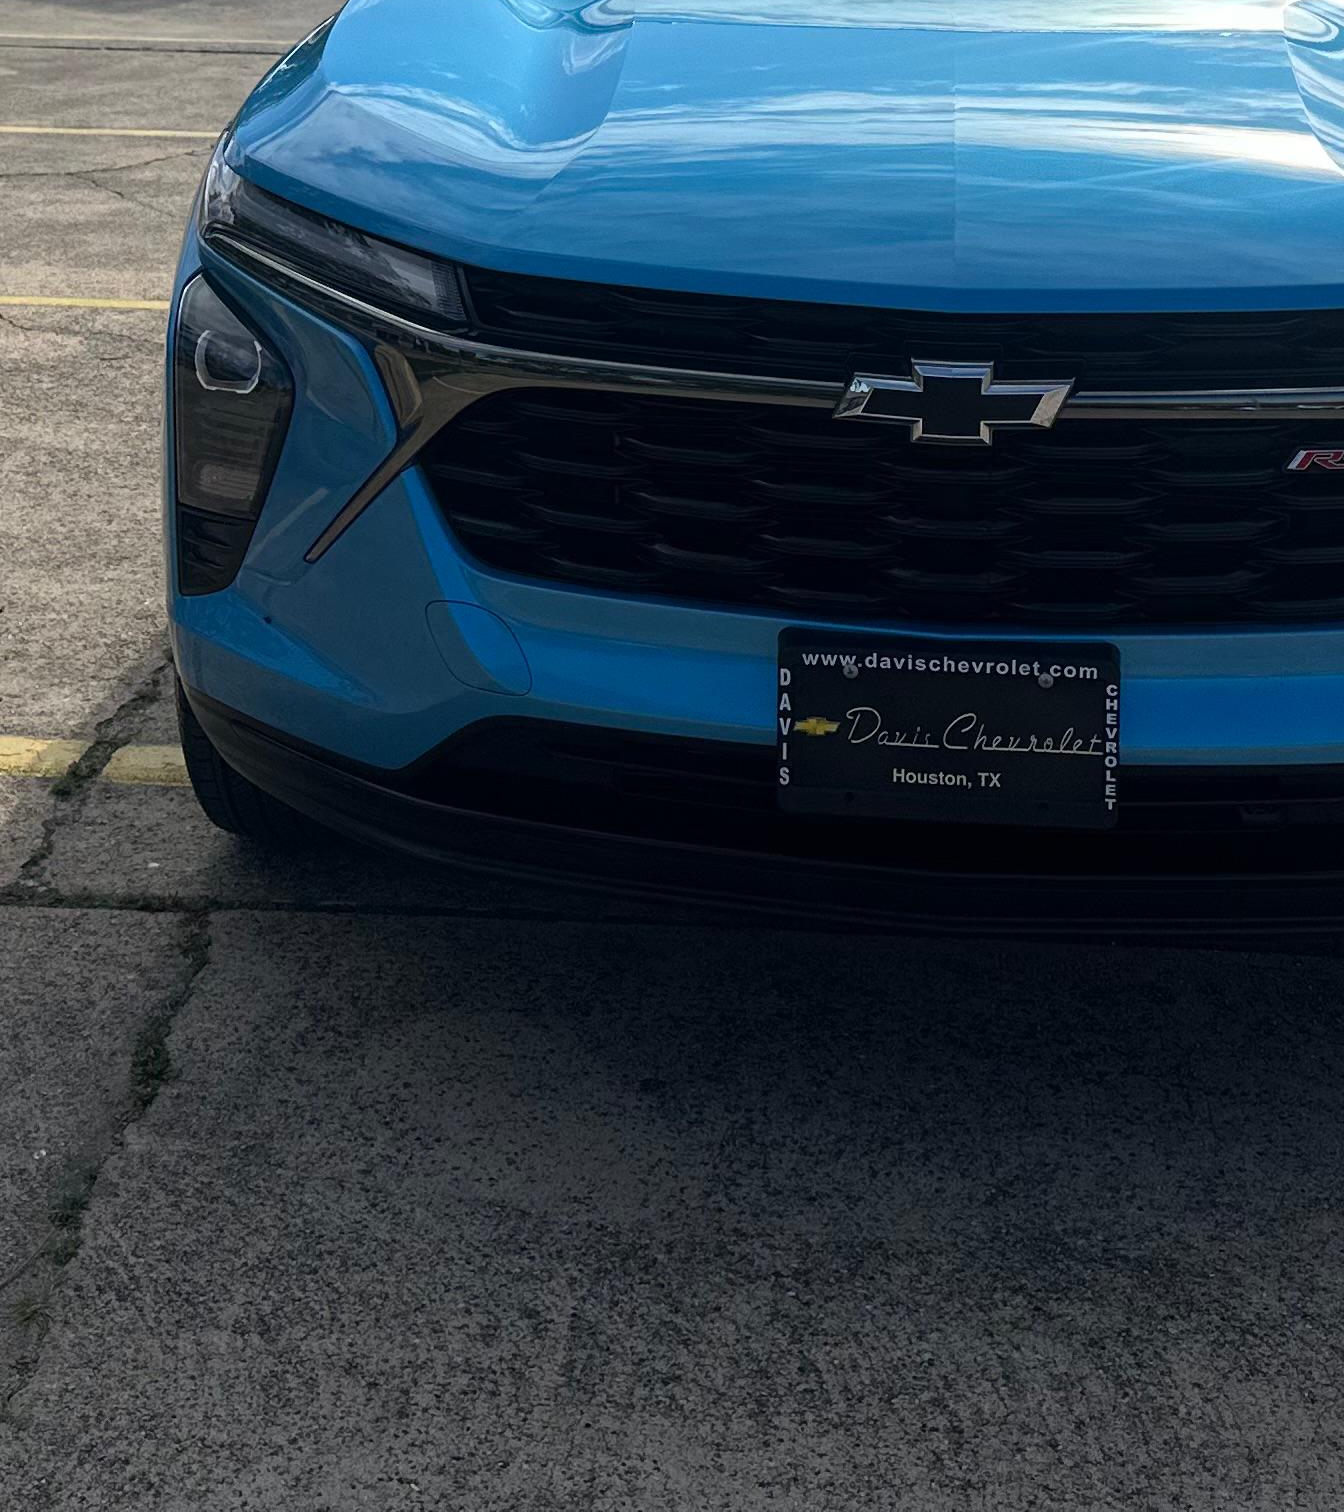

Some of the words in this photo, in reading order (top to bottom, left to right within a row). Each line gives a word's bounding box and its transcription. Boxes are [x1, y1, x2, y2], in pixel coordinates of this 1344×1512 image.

[802, 652, 1099, 680] www.davischevrolet.com
[778, 668, 792, 786] DAVIS
[846, 706, 939, 749] Davis
[943, 713, 1104, 756] Chevrolet
[1104, 684, 1119, 810] CHEVROLET
[892, 768, 972, 789] Houston,
[977, 772, 1002, 788] TX
